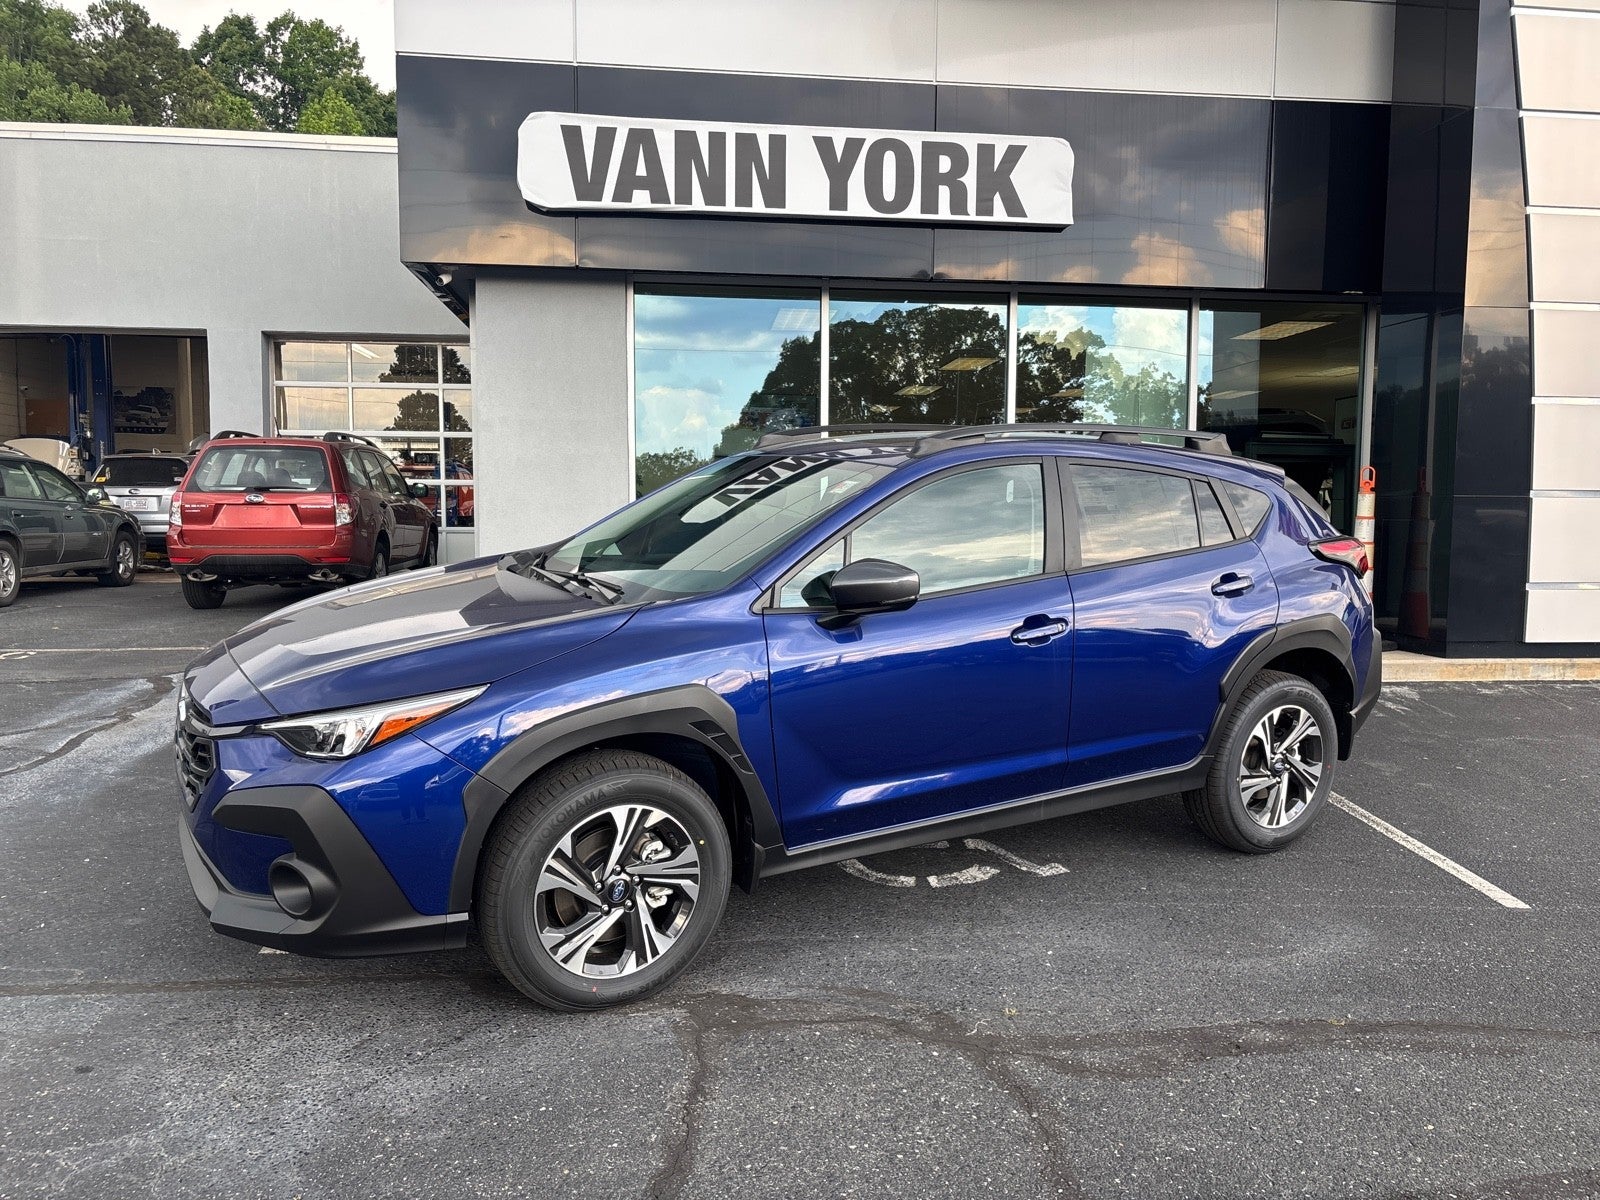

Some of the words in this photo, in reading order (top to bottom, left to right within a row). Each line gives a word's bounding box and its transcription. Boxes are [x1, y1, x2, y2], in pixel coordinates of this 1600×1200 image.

[560, 124, 787, 210] VANN
[811, 135, 1029, 219] YORK
[534, 787, 607, 844] YOKOHAMA
